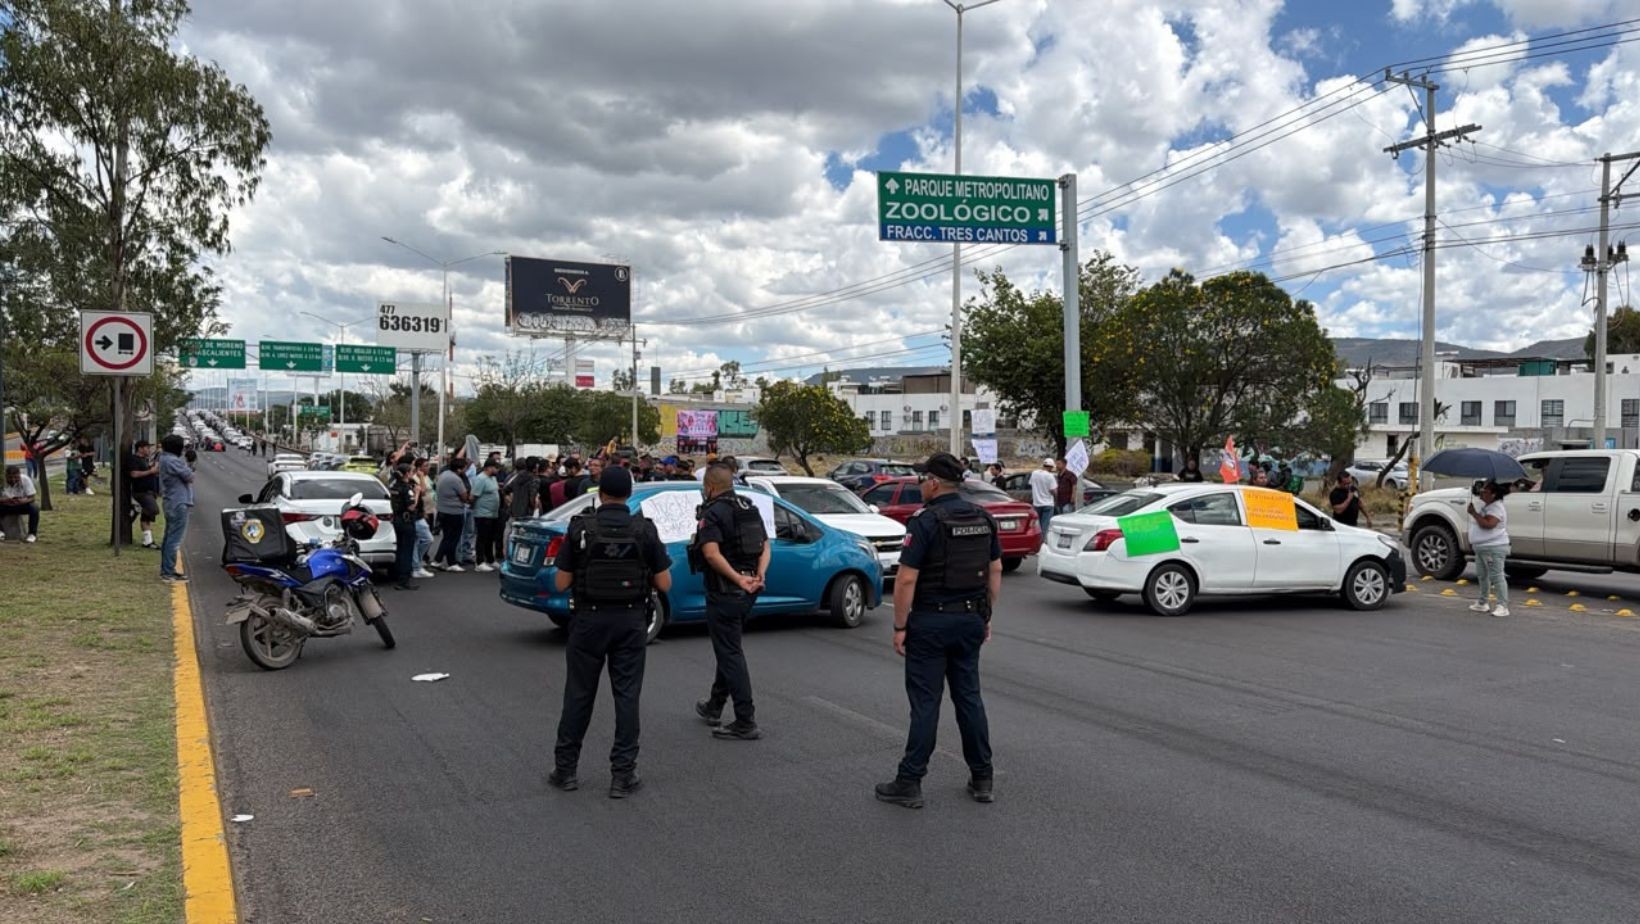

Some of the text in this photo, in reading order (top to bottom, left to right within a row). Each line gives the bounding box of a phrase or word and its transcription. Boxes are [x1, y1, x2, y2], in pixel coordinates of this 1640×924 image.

[904, 178, 1049, 201] PARQUE METROPOLITANO
[885, 199, 1031, 223] ZOOLÓGICO
[886, 224, 1028, 242] FRACC. TRES CANTOS
[379, 304, 395, 314] 477
